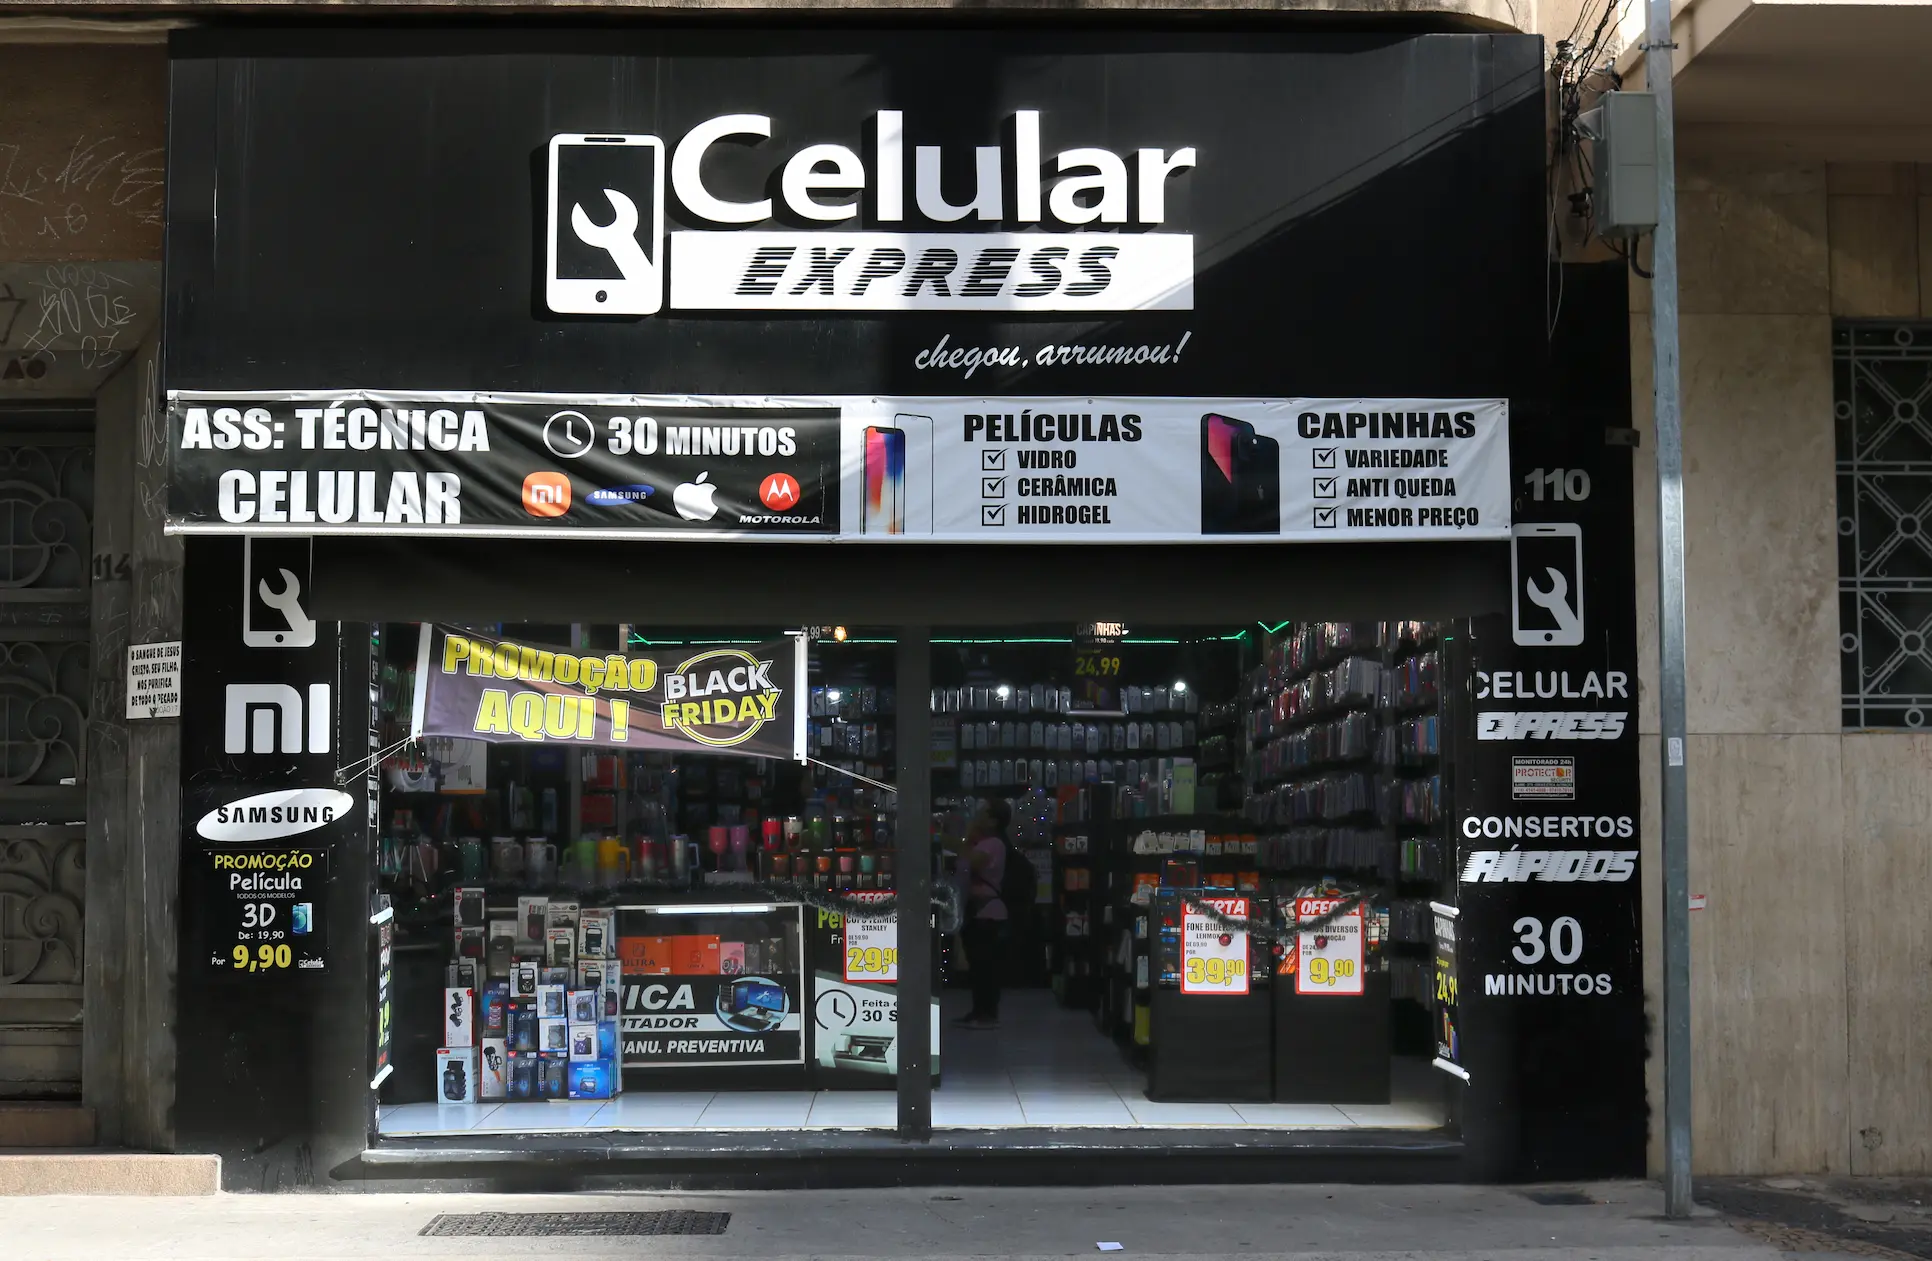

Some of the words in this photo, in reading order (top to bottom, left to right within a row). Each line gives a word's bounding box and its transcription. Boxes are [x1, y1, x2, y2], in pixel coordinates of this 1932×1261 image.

[671, 109, 1196, 224] Celular
[734, 246, 1120, 297] EXPRESS
[914, 333, 1029, 379] chegou,
[1035, 331, 1192, 366] arrumou!
[180, 407, 284, 450] ASS:
[294, 402, 491, 452] TÉCNICA
[607, 416, 657, 456] 30
[665, 426, 797, 456] MINUTOS
[963, 409, 1143, 442] PELÍCULAS
[1297, 411, 1477, 439] CAPINHAS
[1017, 449, 1077, 470] VIDRO
[1345, 448, 1449, 469] VARIEDADE
[593, 490, 647, 500] SAMSUNG
[1017, 474, 1118, 498] CERÂMICA
[1346, 477, 1390, 498] ANTI
[1394, 478, 1456, 499] QUEDA
[1525, 468, 1591, 501] 110
[217, 470, 462, 525] CELULAR
[738, 515, 821, 524] MOTOROLA
[1017, 505, 1111, 525] HIDROGEL
[1346, 507, 1413, 527] MENOR
[1417, 507, 1479, 529] PREÇO
[136, 648, 155, 660] SANGUE
[157, 648, 163, 657] DE
[165, 646, 179, 657] JESUS
[442, 634, 658, 694] PROMOÇÃO
[152, 663, 160, 673] SEU
[1075, 657, 1120, 676] 24,99
[149, 678, 171, 689] PURIFICA
[664, 659, 774, 700] BLACK
[1467, 671, 1629, 699] CELULAR
[131, 695, 138, 706] DE
[662, 688, 782, 729] FRIDAY
[473, 689, 597, 741] AQUI
[1477, 711, 1629, 740] EXPRESS
[217, 806, 334, 824] SAMSUNG
[1462, 816, 1634, 838] CONSERTOS
[214, 850, 313, 871] PROMOÇÃO
[1460, 844, 1639, 882] RÁPIDOS
[229, 871, 302, 890] Película
[242, 903, 276, 928] 3D
[238, 931, 254, 939] De:
[258, 930, 284, 940] 19,90
[1512, 916, 1583, 965] 30
[211, 957, 226, 965] Por
[232, 944, 292, 972] 9,90
[1186, 958, 1245, 986] 39,90
[1309, 958, 1354, 986] 9,90
[1485, 973, 1613, 996] MINUTOS
[622, 984, 696, 1010] ICA
[862, 1010, 882, 1021] 30
[667, 1040, 765, 1053] PREVENTIVA
